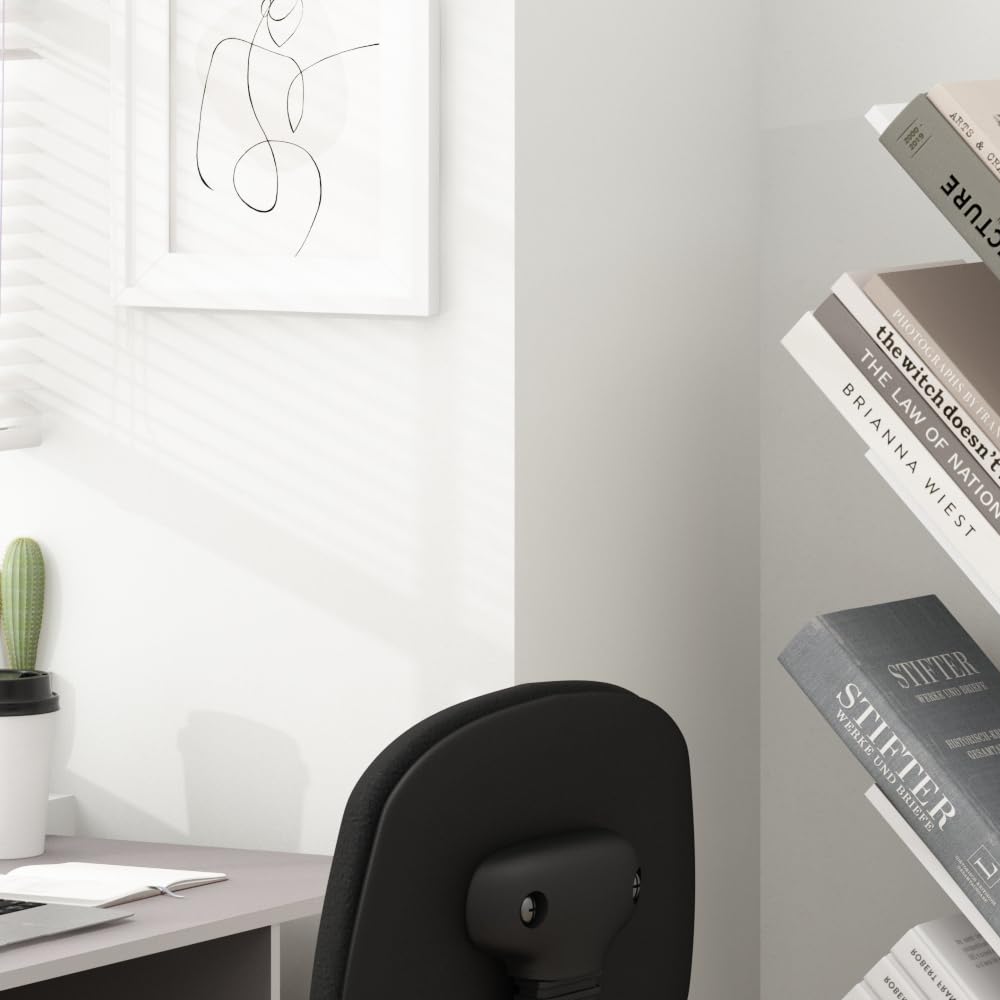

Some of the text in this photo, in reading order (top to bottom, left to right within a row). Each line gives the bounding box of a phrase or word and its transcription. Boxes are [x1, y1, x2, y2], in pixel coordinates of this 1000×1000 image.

[949, 112, 974, 138] ARTS
[976, 140, 984, 151] &
[860, 347, 893, 388] THE
[891, 386, 927, 425] LAW
[925, 426, 950, 449] OF
[876, 325, 903, 359] the
[901, 355, 944, 409] witch
[891, 308, 965, 393] PHOTOGRAPHS
[962, 391, 976, 408] BY
[842, 383, 976, 537] BRIANNA WIEST
[887, 651, 981, 689] STIFTER
[836, 683, 956, 831] STIFTER
[836, 708, 935, 832] WERKE UND BRIEFE
